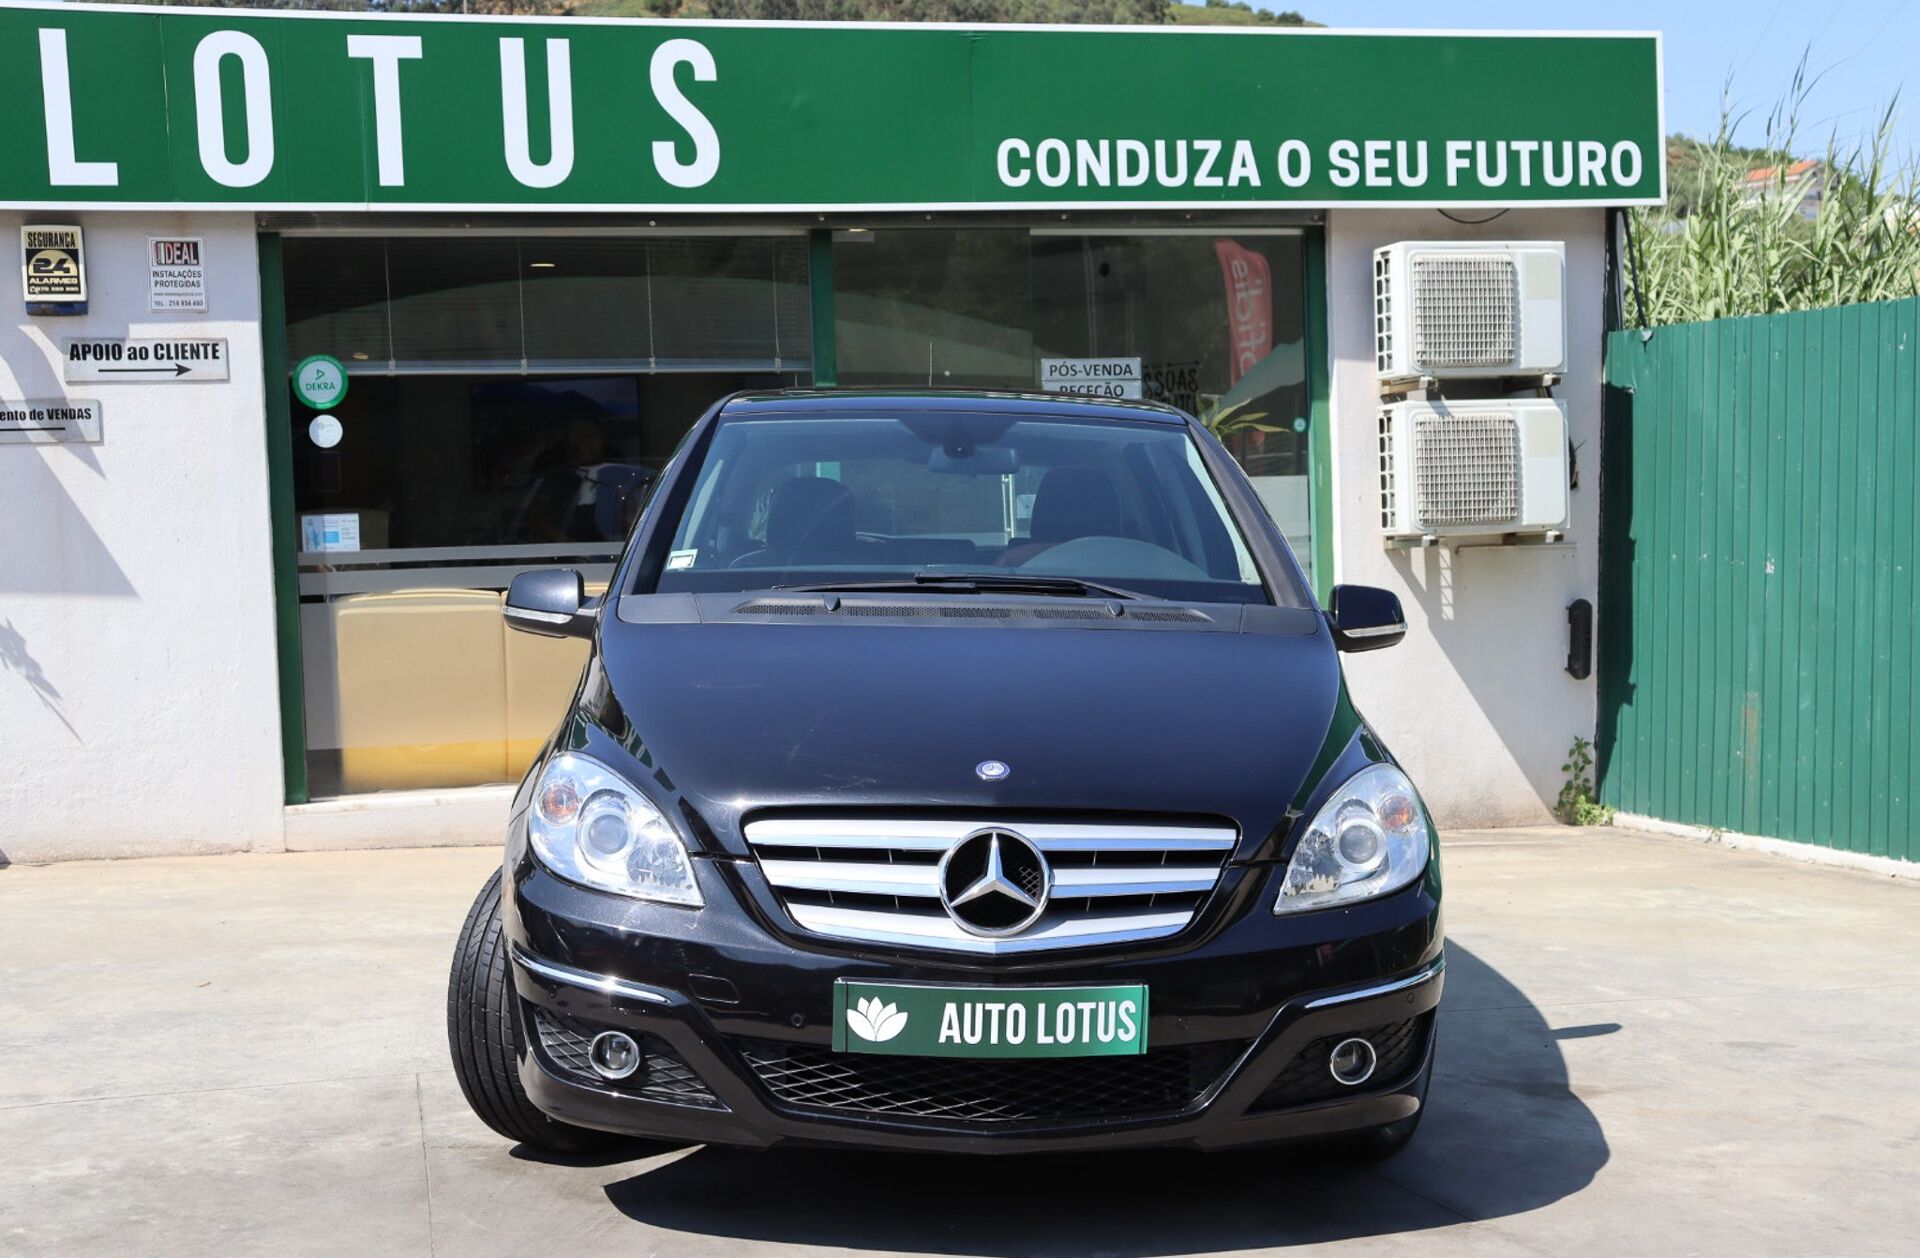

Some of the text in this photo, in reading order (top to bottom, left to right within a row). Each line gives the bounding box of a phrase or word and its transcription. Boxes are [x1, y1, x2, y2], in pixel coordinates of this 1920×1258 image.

[38, 27, 721, 189] LOTUS
[996, 138, 1643, 188] CONDUZA O SEU FUTURO
[33, 257, 71, 274] 24
[152, 269, 202, 279] INSTALAÇÕES
[154, 280, 201, 288] PROTEGIDAS
[69, 343, 220, 361] APOIO ao CLIENTE
[1049, 361, 1134, 377] PÓS-VENDA
[305, 382, 336, 391] DEKRA
[29, 408, 45, 421] de
[46, 407, 92, 420] VENDAS
[937, 1000, 1137, 1045] AUTO LOTUS
